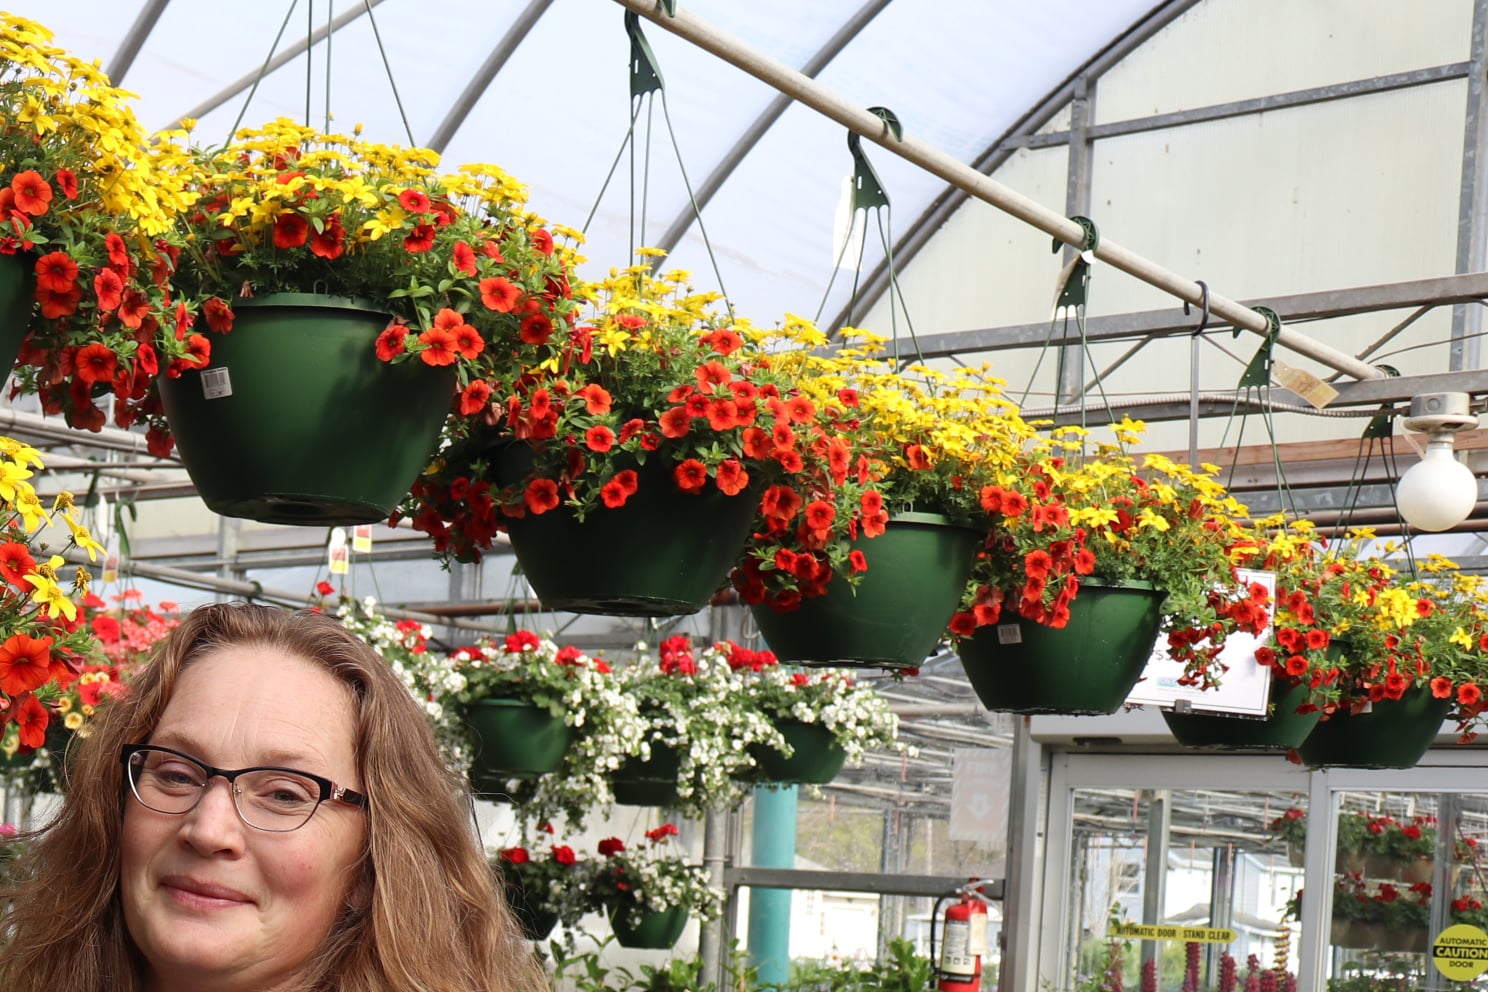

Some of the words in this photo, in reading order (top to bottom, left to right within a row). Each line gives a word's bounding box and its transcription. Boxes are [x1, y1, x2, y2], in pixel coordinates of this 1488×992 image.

[1116, 926, 1154, 936] AUTOMATIC
[1157, 928, 1176, 937] DOOR
[1183, 930, 1205, 939] STAND
[1208, 931, 1230, 940] CLEAR
[1436, 947, 1488, 958] CAUTION
